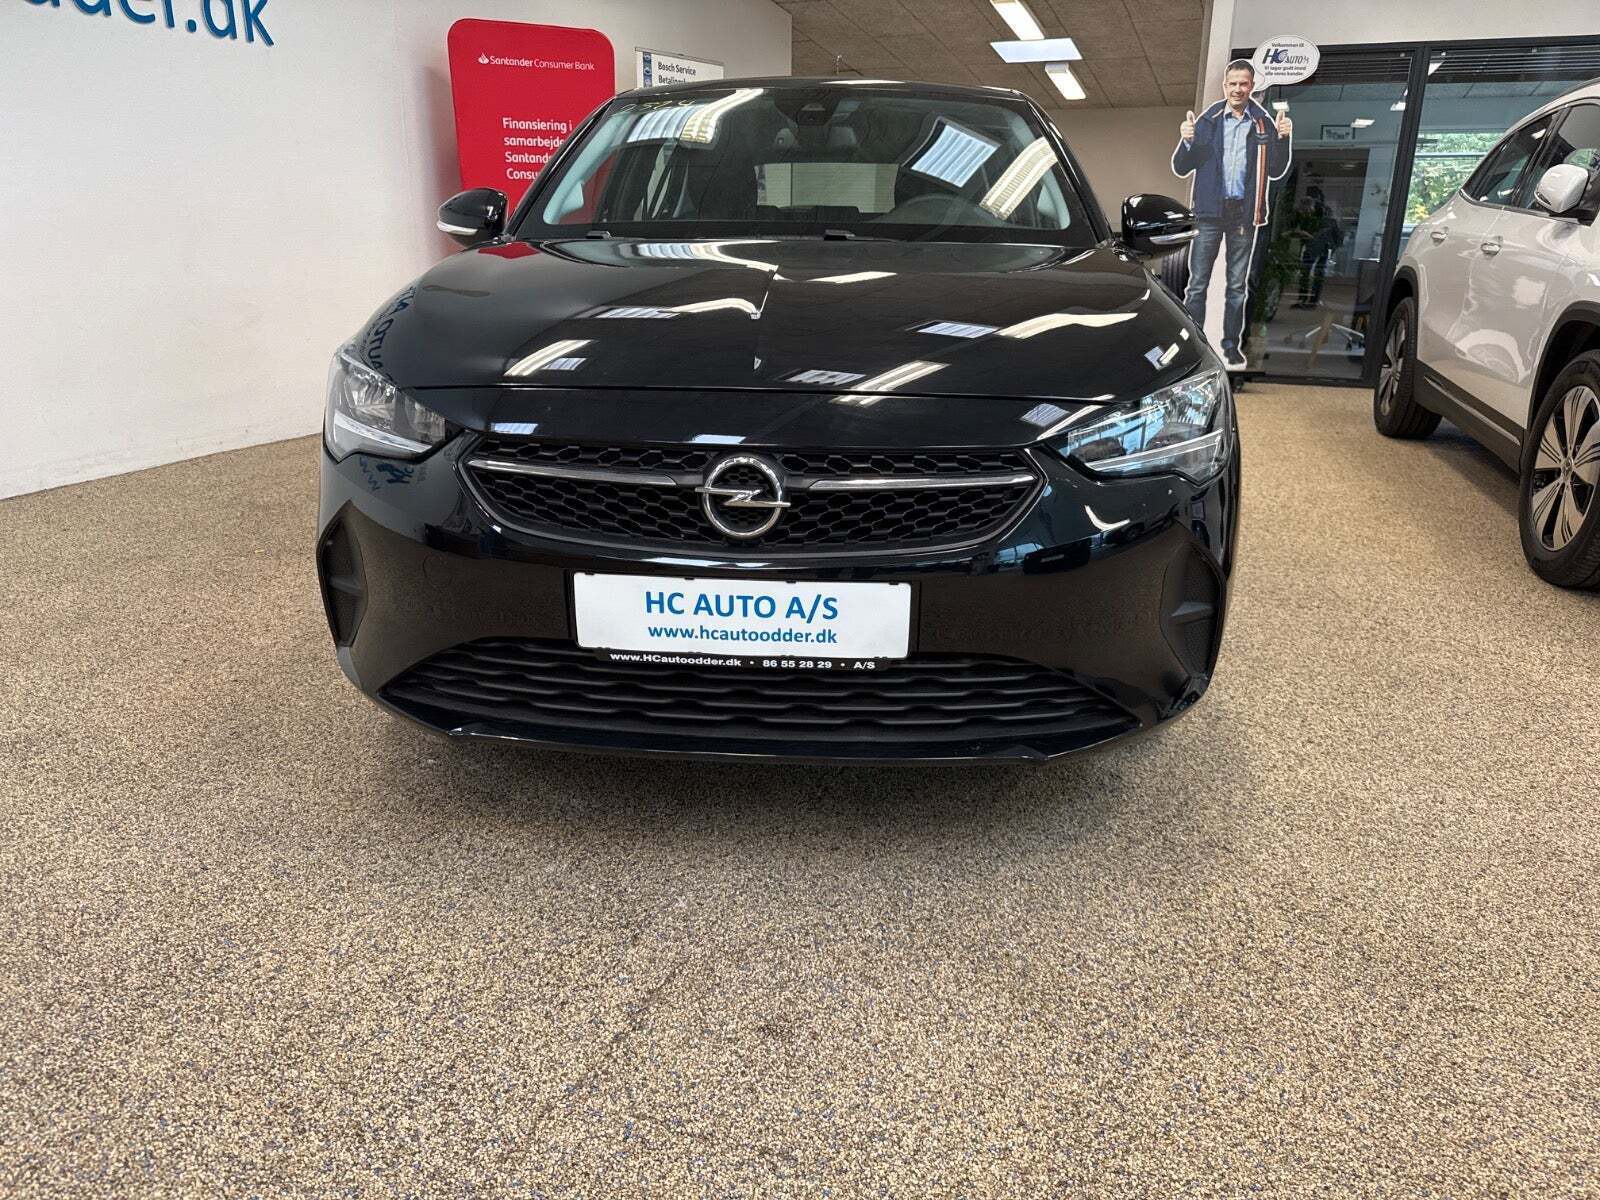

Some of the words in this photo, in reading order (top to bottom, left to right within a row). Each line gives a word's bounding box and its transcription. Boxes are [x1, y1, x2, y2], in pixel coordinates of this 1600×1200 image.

[490, 55, 533, 67] Santander
[534, 58, 575, 69] Consumer
[575, 61, 595, 70] Bank
[1262, 48, 1288, 64] HC
[658, 61, 675, 72] Bosch
[675, 64, 697, 76] Service
[502, 117, 567, 134] Finansiering
[569, 119, 573, 131] i
[505, 152, 552, 164] Santand
[645, 591, 684, 614] HC
[693, 593, 776, 618] AUTO
[785, 594, 838, 624] A/S
[648, 625, 838, 643] www.hcautoodder.dk
[610, 653, 742, 666] www.HCautoodder.dk
[762, 659, 778, 667] 86
[780, 660, 795, 668] 55
[799, 660, 814, 668] 28
[853, 661, 875, 669] A/S
